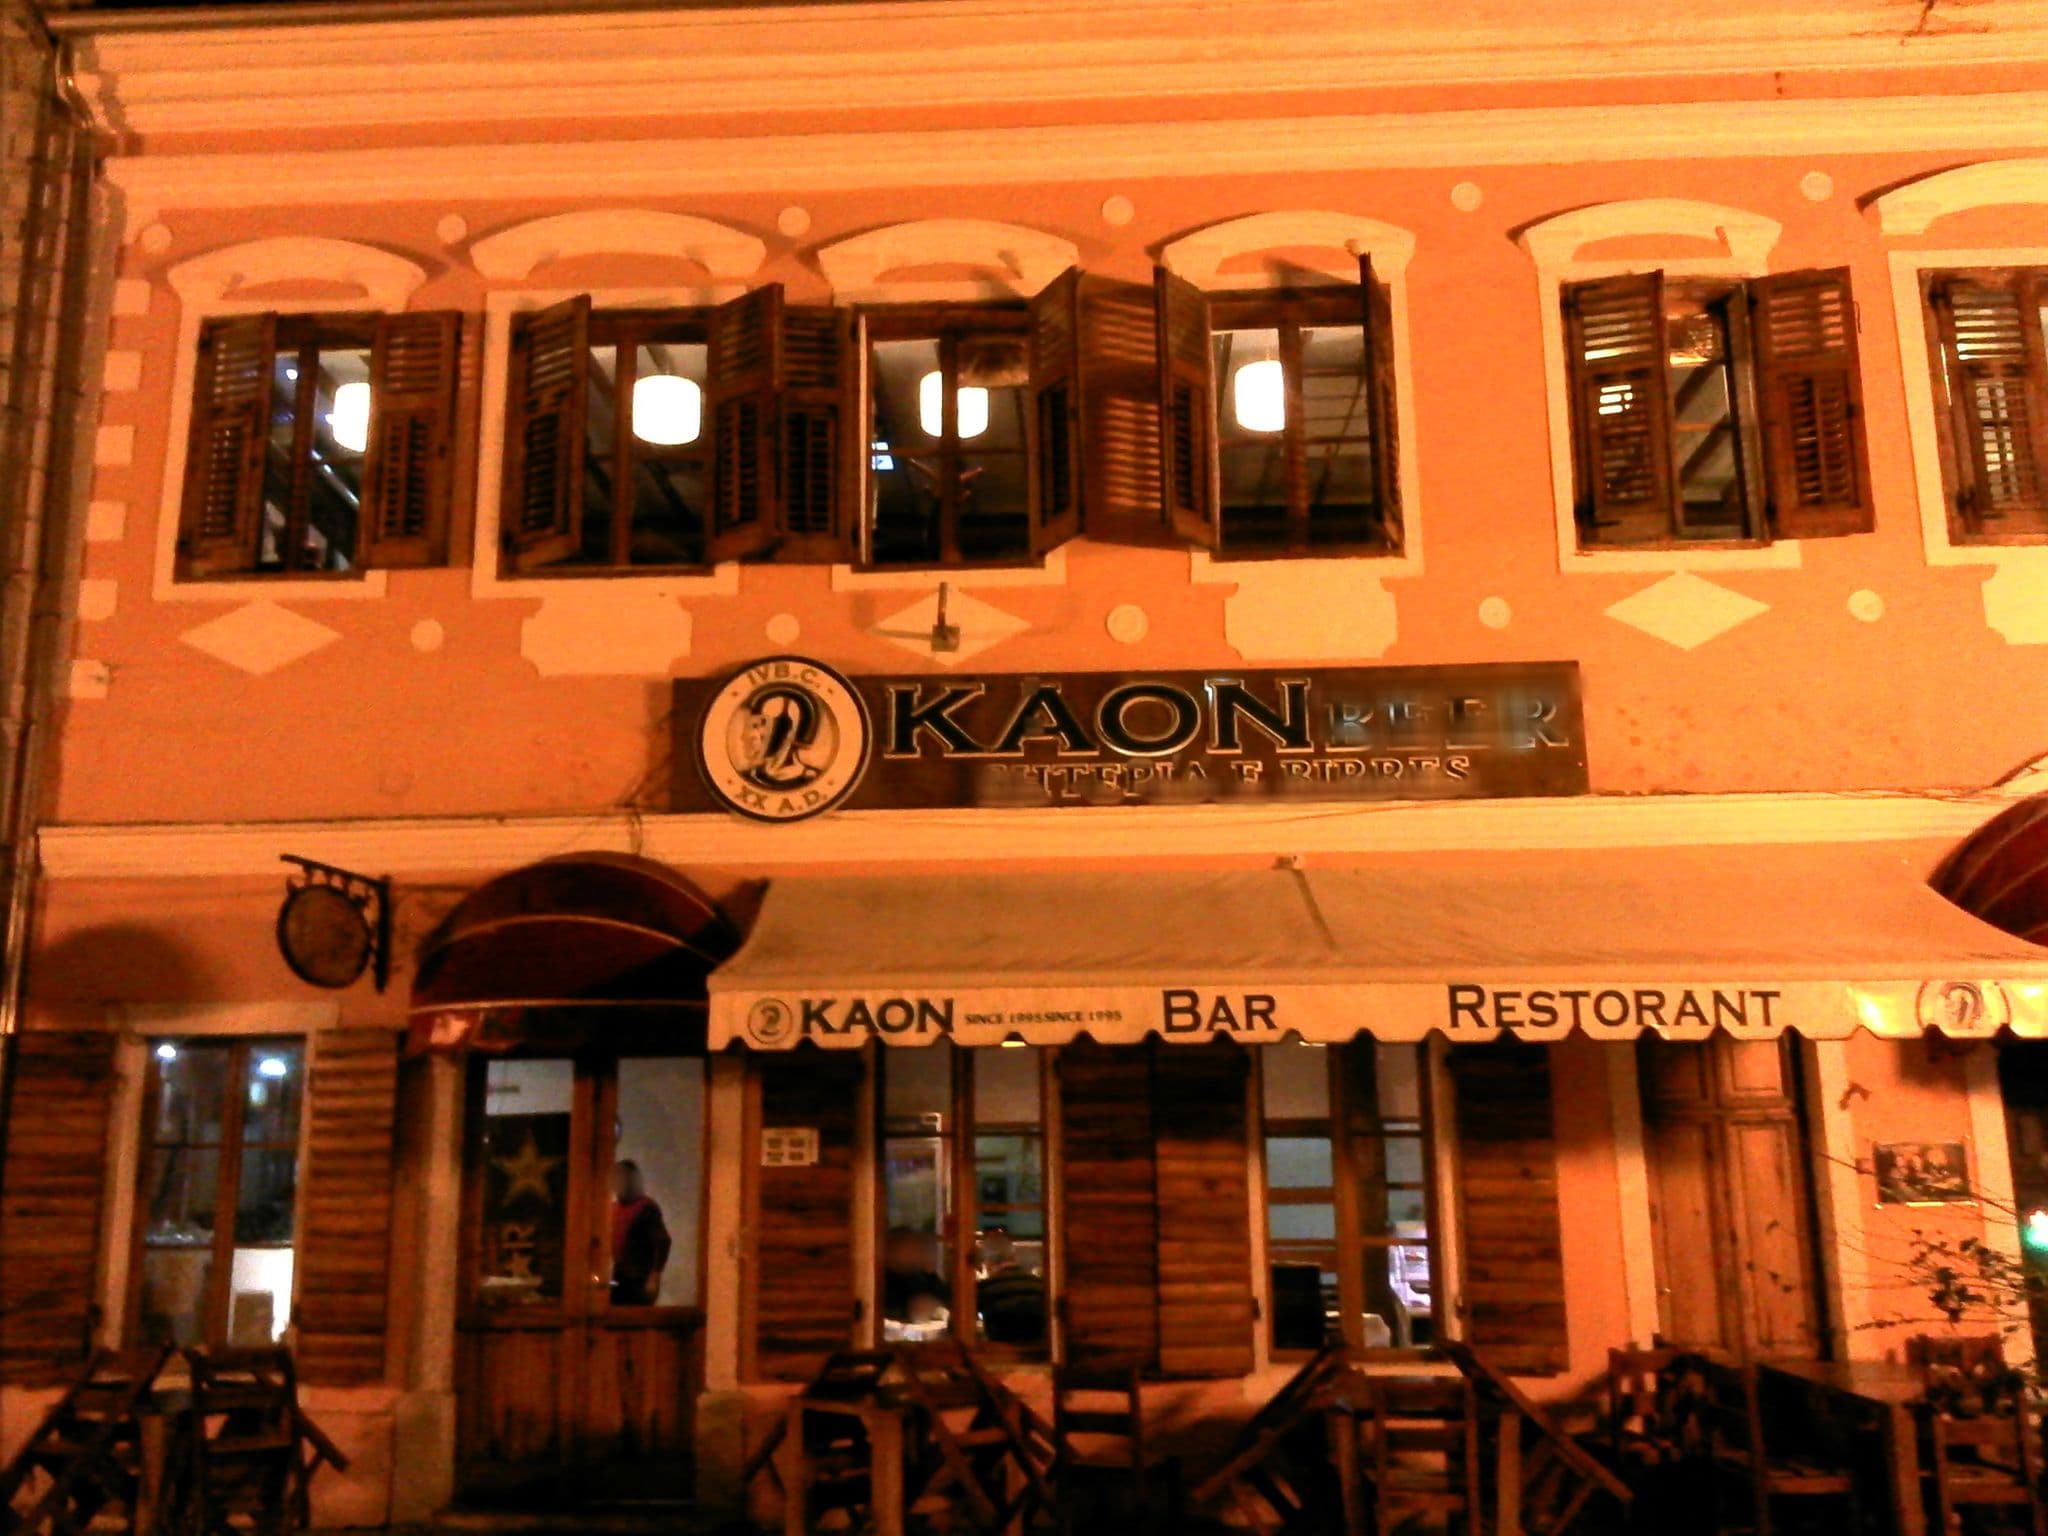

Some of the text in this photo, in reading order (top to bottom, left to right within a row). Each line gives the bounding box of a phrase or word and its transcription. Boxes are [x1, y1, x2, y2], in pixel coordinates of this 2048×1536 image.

[883, 677, 1315, 759] KAON
[802, 998, 954, 1034] KAON
[965, 1013, 1003, 1024] SINCE
[1163, 988, 1278, 1033] BAR
[1448, 983, 1780, 1028] RESTORANT
